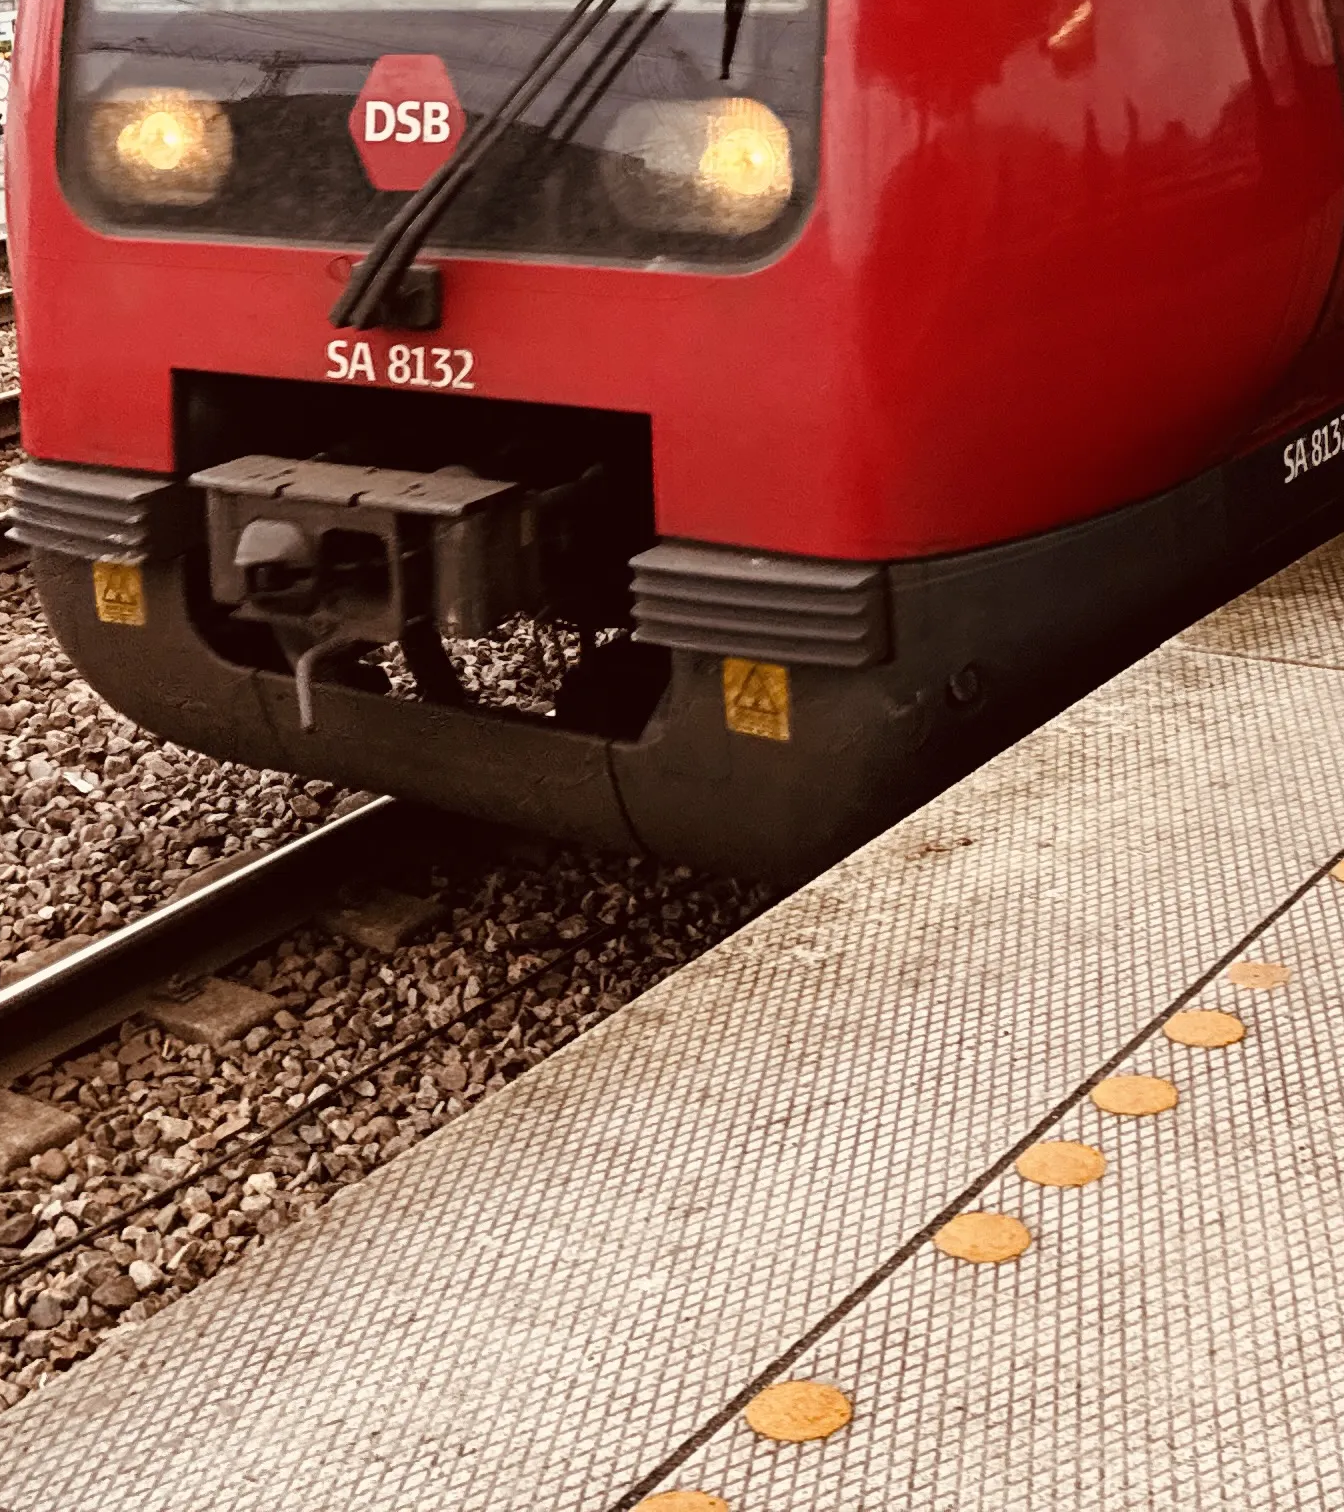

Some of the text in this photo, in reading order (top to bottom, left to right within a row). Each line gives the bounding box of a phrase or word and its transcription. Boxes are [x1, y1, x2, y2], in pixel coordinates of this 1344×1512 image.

[364, 101, 451, 144] DSB
[326, 340, 475, 390] SA 8132
[1283, 438, 1308, 484] SA
